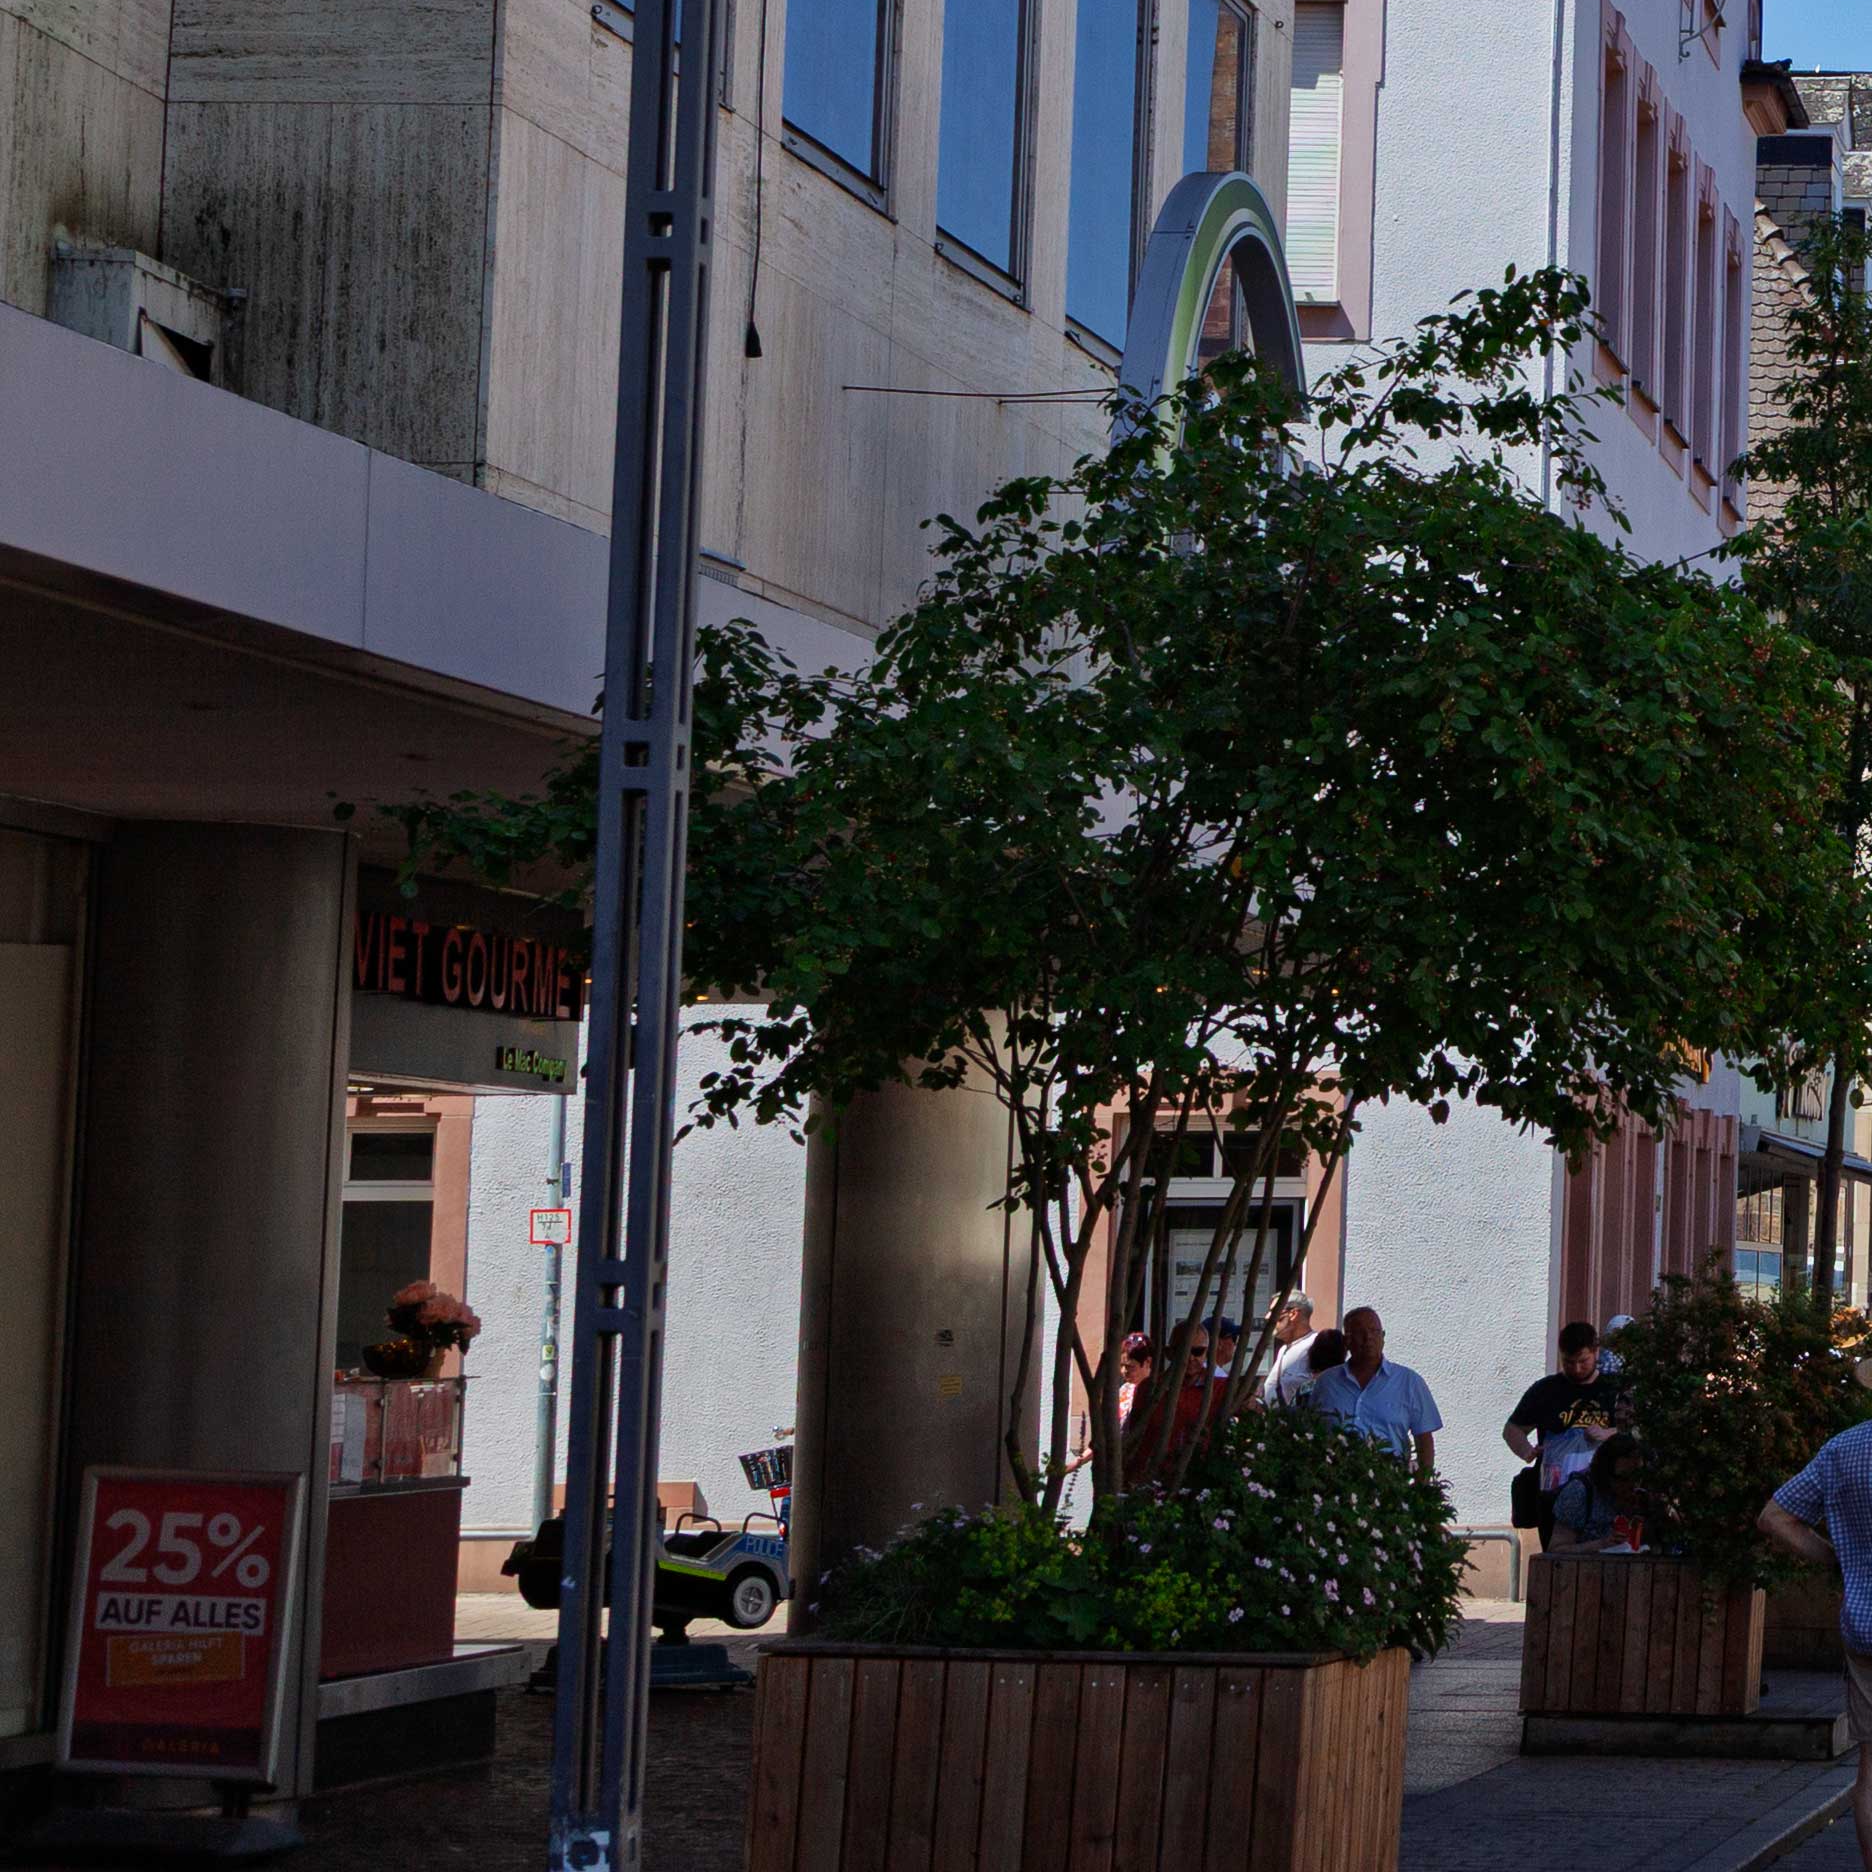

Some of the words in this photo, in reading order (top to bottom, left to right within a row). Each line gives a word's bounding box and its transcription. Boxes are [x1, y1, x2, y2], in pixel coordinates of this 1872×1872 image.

[354, 913, 430, 996] VIET
[504, 1048, 513, 1072] Le
[100, 1508, 270, 1589] 25%
[100, 1597, 163, 1625] AUF
[170, 1601, 262, 1629] ALLES
